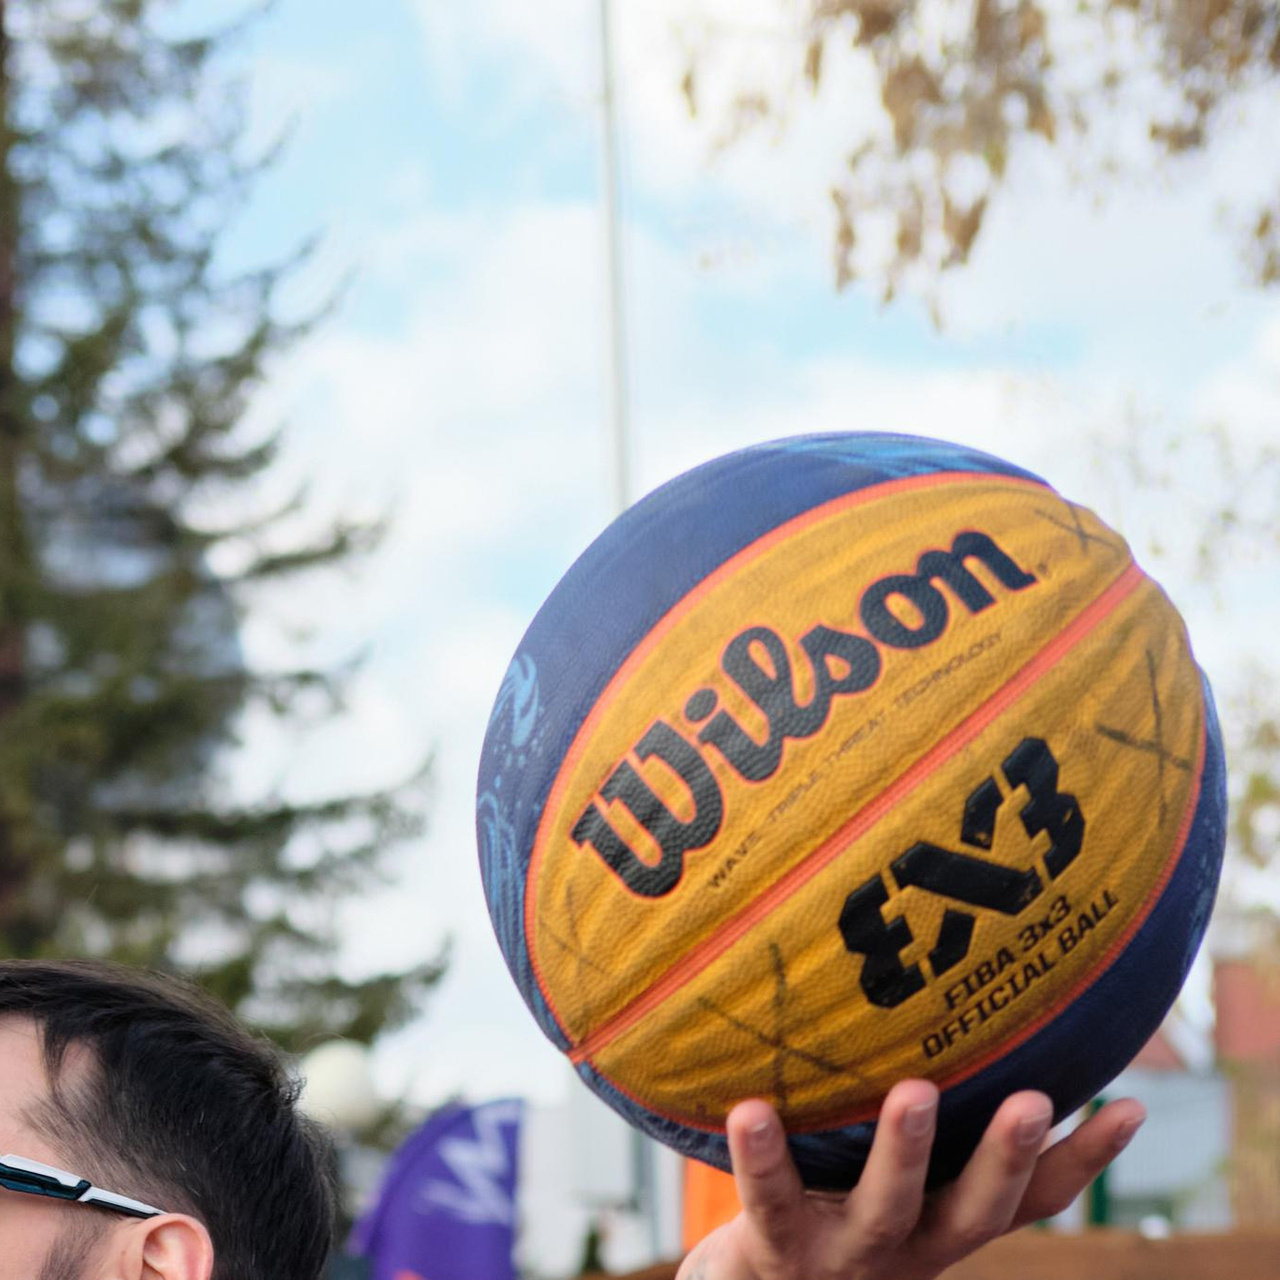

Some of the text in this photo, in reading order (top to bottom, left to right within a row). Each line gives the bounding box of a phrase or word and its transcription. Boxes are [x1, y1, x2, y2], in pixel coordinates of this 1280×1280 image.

[570, 530, 1036, 898] Wilson
[708, 831, 760, 888] WAVE
[921, 888, 1120, 1060] OFFICIAL BALL
[943, 893, 1071, 1012] FIBA 3x3
